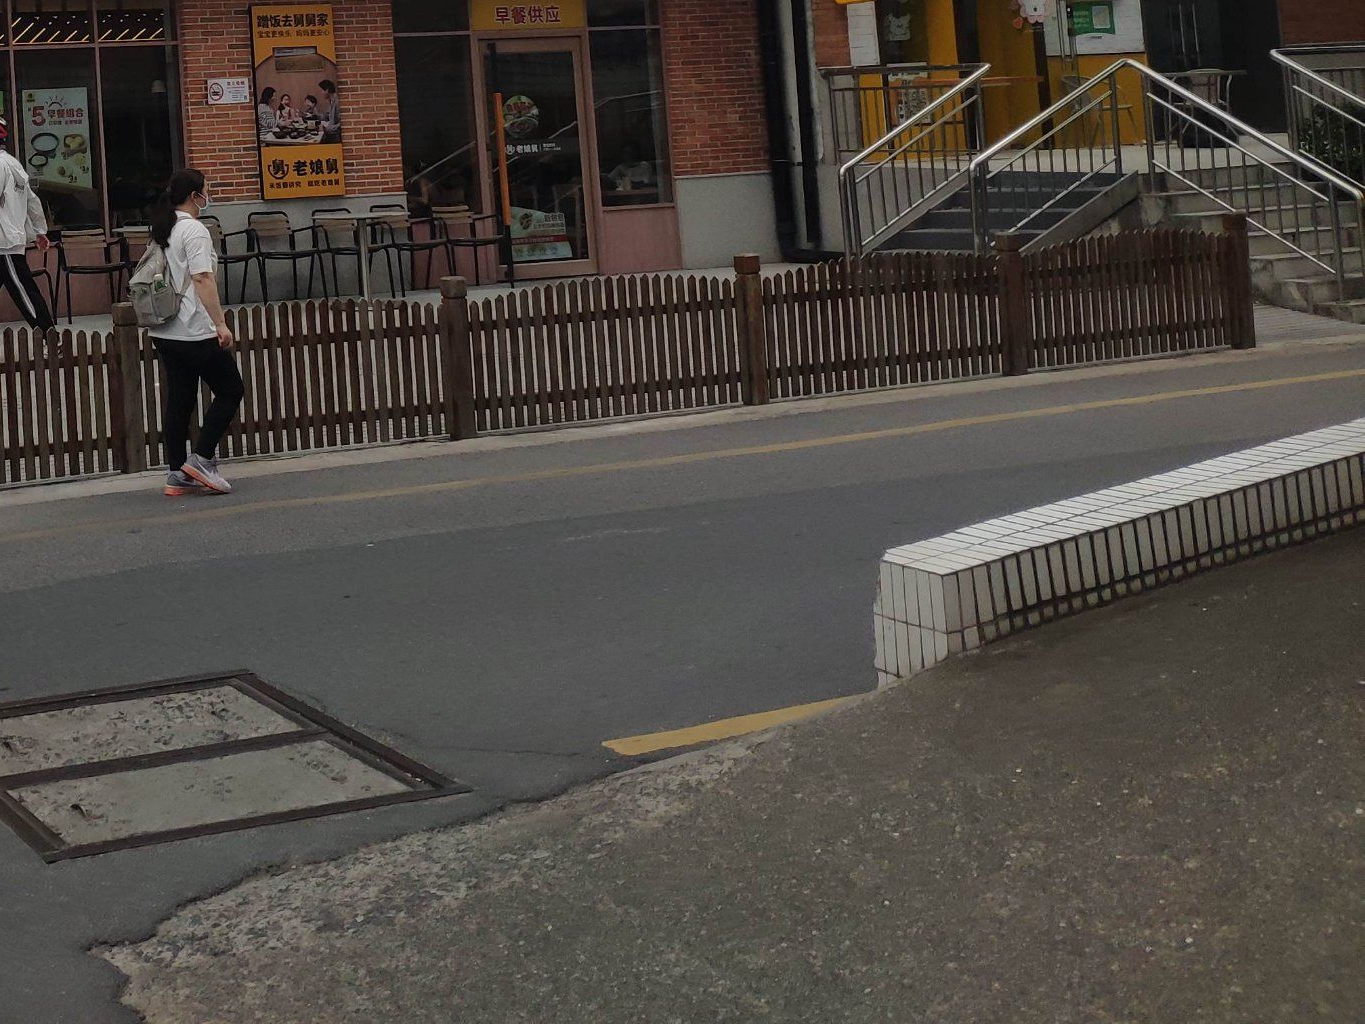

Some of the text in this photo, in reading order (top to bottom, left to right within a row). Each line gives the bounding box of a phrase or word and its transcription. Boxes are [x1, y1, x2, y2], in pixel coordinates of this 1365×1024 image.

[257, 13, 328, 28] 蹭饭去舅舅家
[495, 5, 561, 24] 早餐供应
[47, 108, 84, 118] 早餐组合
[293, 158, 339, 176] 老娘舅
